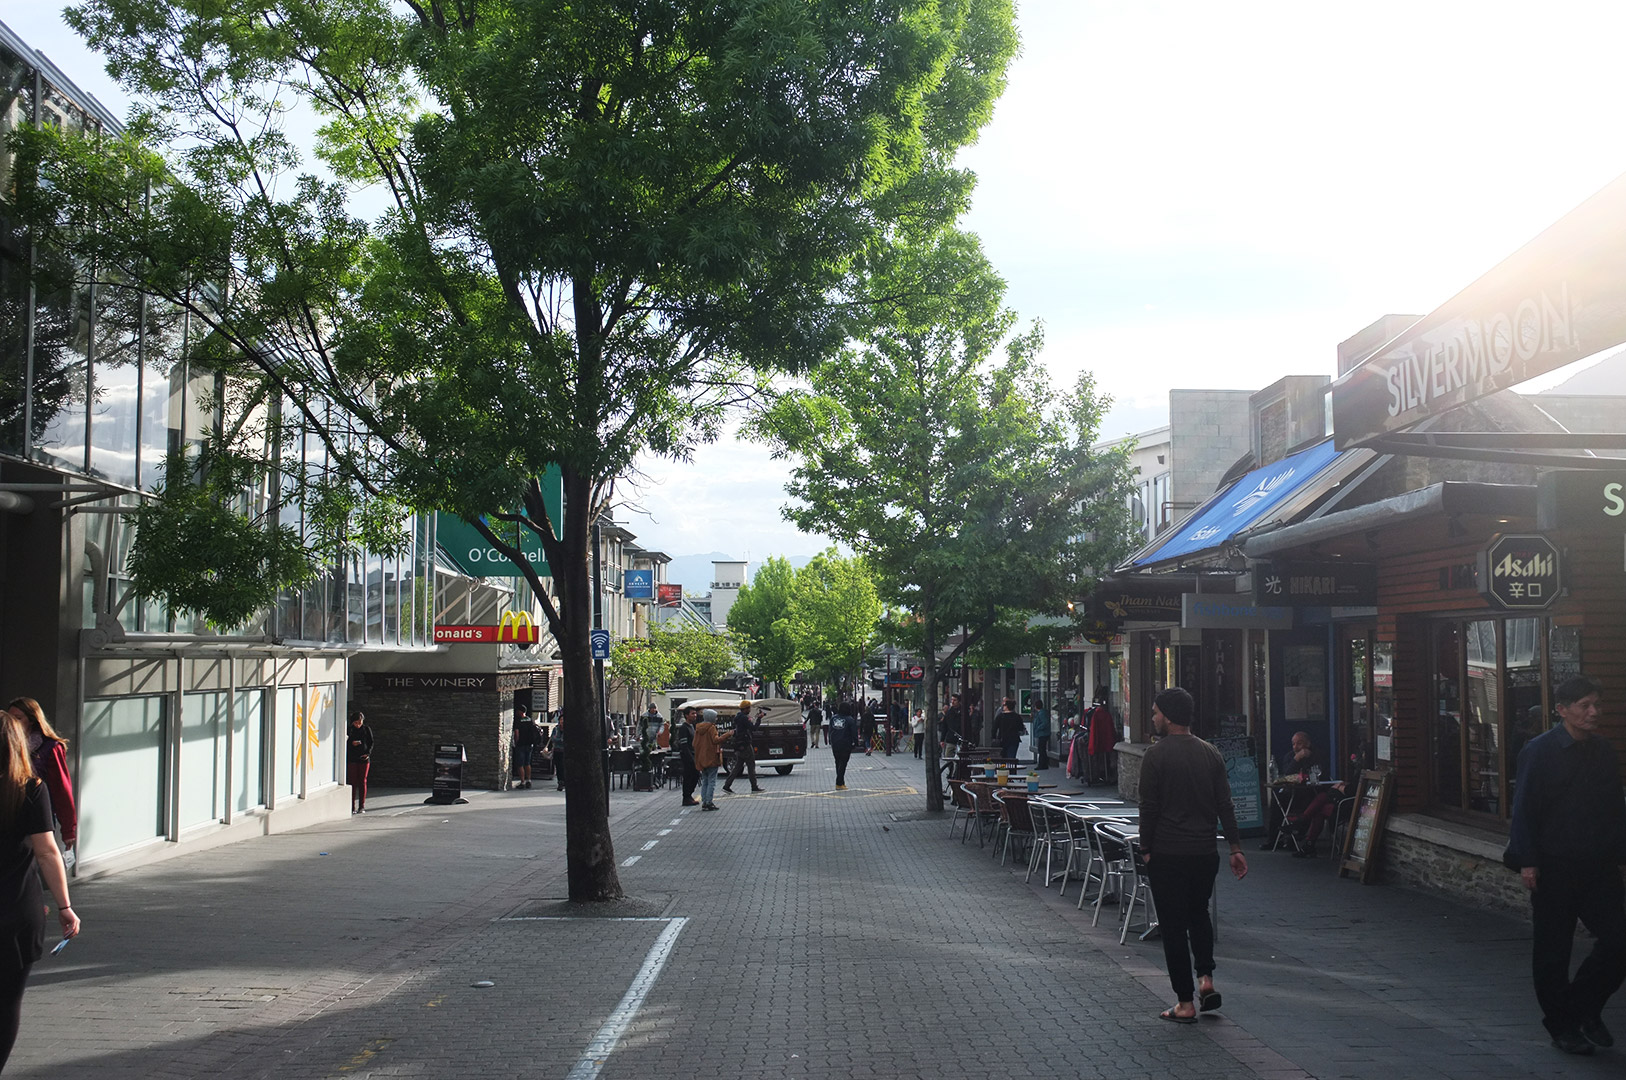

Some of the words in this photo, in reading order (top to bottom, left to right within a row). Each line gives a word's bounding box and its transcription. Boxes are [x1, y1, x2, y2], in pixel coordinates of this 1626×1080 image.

[1387, 281, 1574, 417] SILVERMOON
[1494, 553, 1553, 578] Asahi
[1265, 575, 1281, 595] 光
[1290, 576, 1335, 596] HIKARI
[1508, 581, 1542, 599] 辛口
[1120, 594, 1153, 606] Tham
[1155, 595, 1181, 608] Nak
[1193, 601, 1257, 617] fishbone
[1215, 640, 1225, 685] THAI
[385, 677, 415, 687] THE
[420, 678, 486, 687] WINERY
